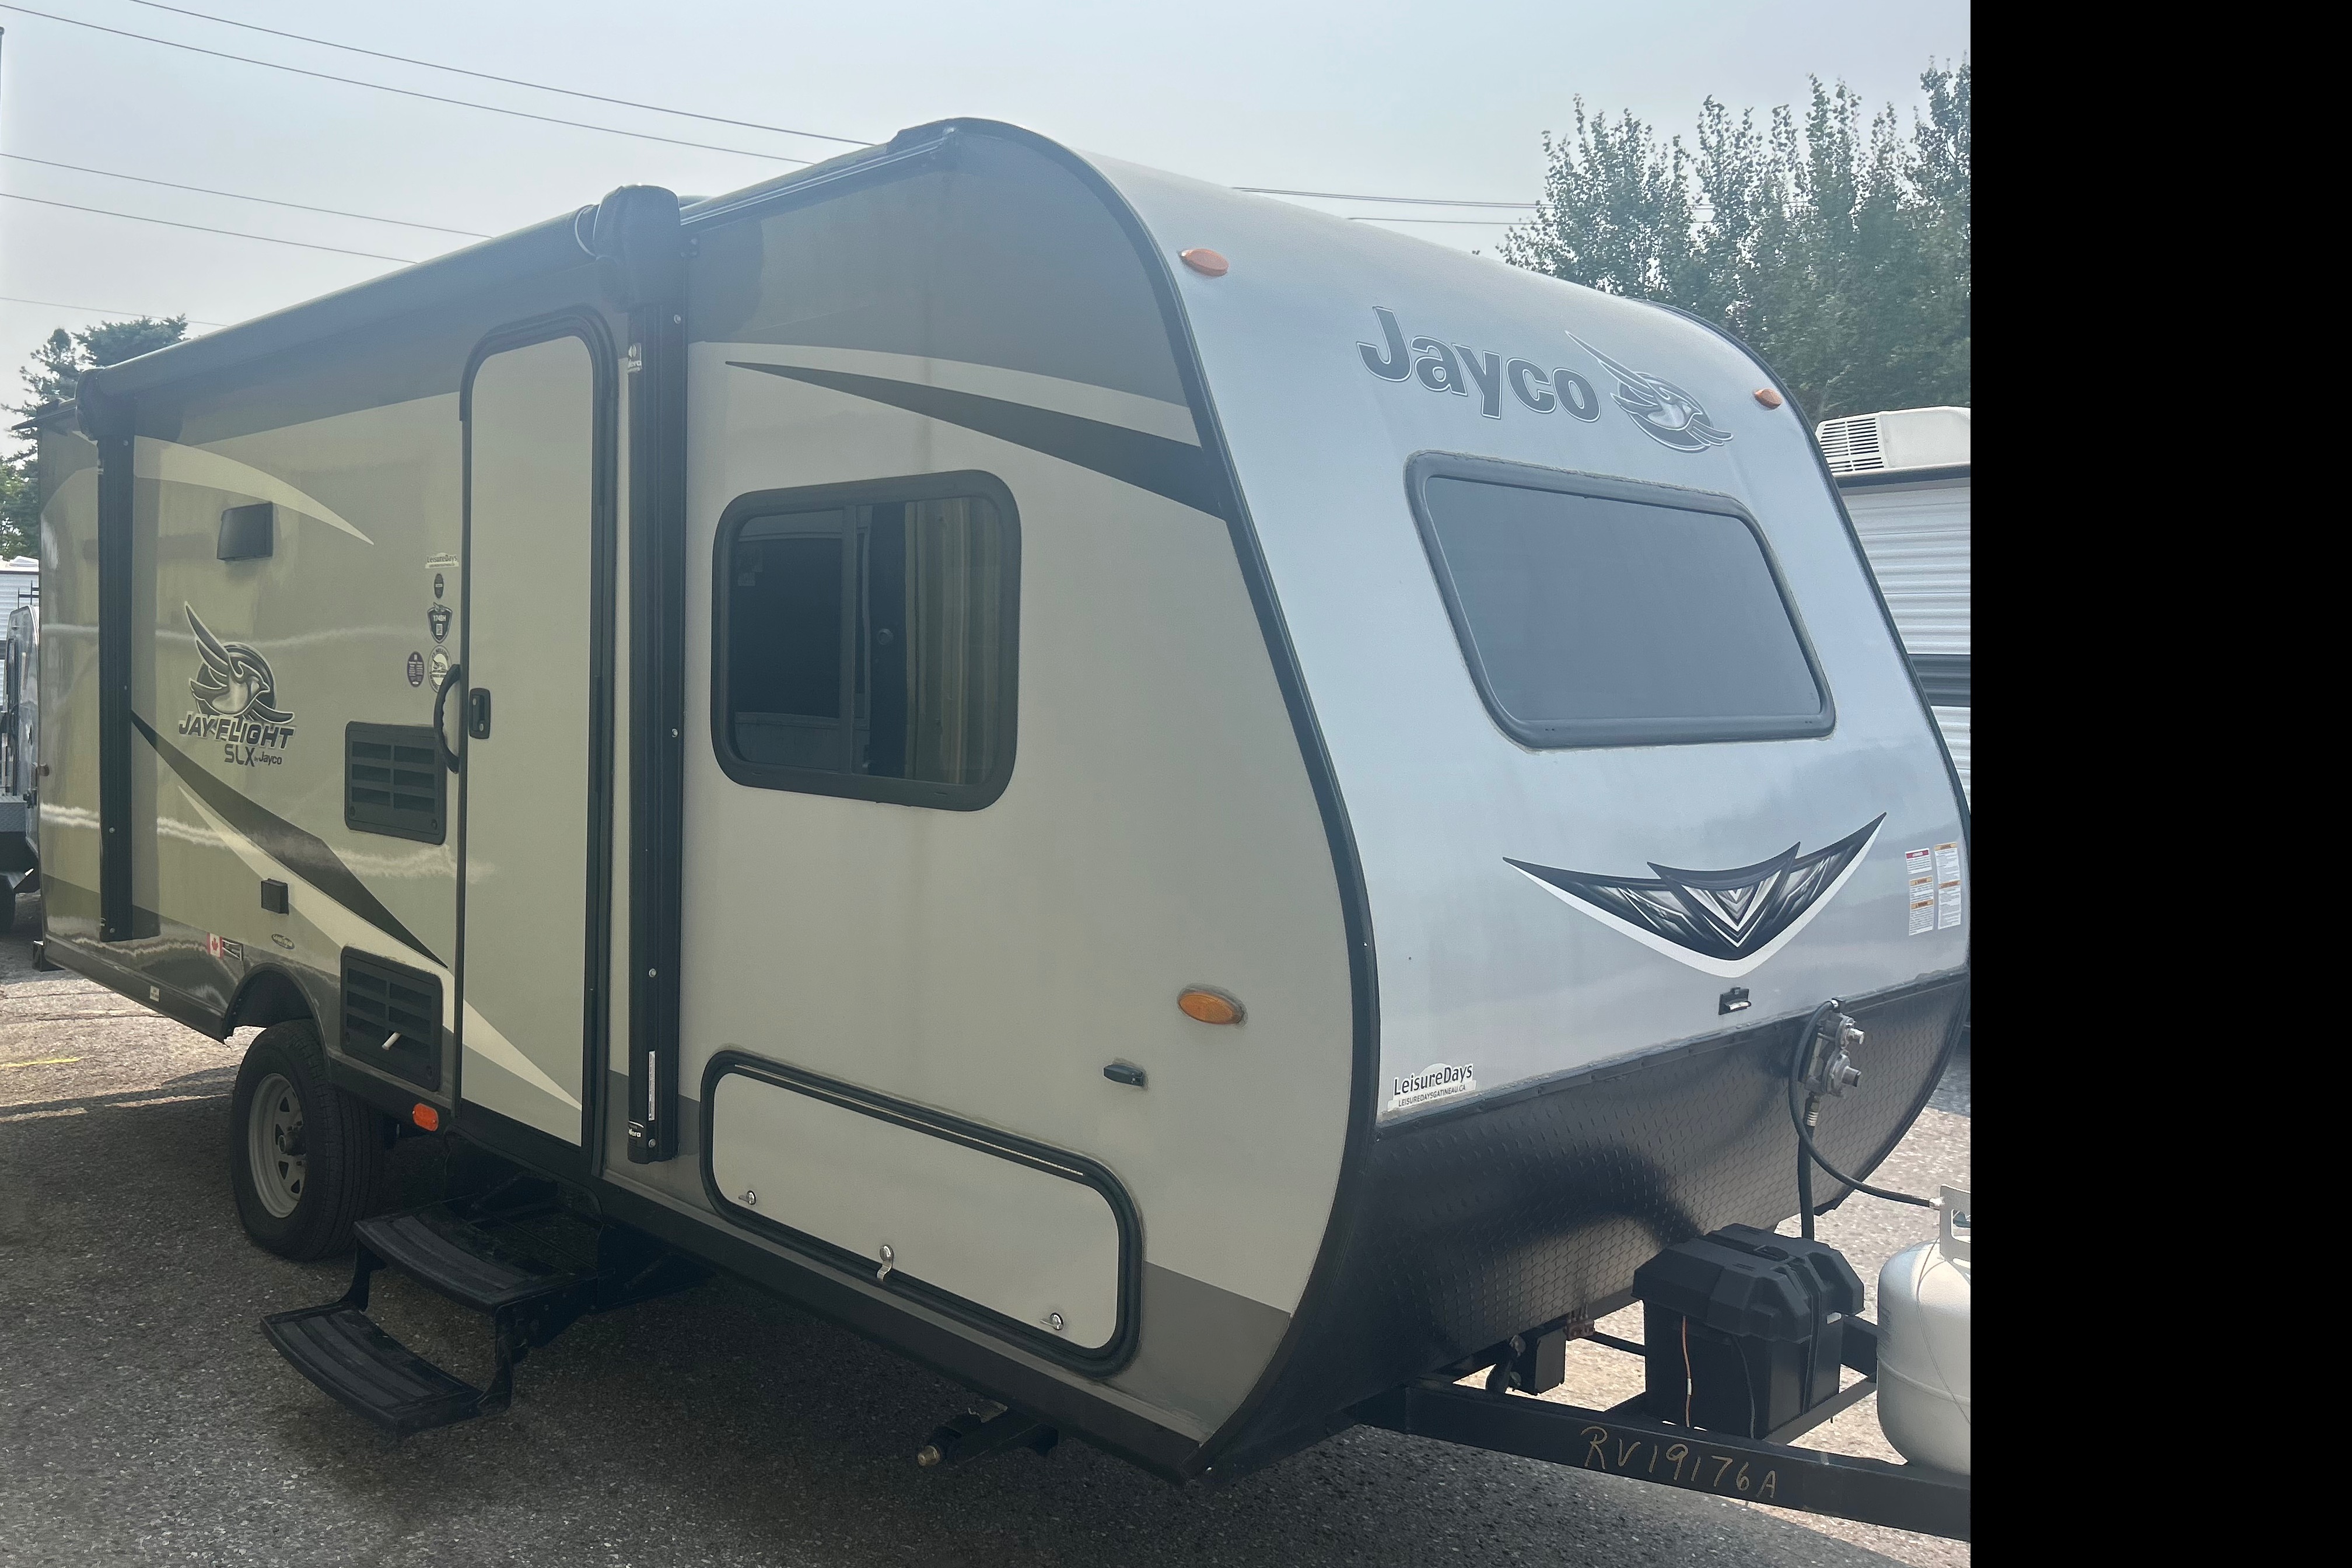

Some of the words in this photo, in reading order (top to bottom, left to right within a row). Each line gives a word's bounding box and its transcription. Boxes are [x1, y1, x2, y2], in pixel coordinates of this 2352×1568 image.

[1356, 306, 1601, 422] Jayco
[178, 713, 216, 737] JAY
[215, 718, 295, 749] FLIGHT
[224, 743, 255, 767] SLX
[259, 751, 282, 766] Jayco
[1394, 1065, 1472, 1096] LeisureDays
[1398, 1084, 1466, 1107] LEISUREDAYSGATINEAU.CA
[1580, 1425, 1777, 1499] RV19176A
